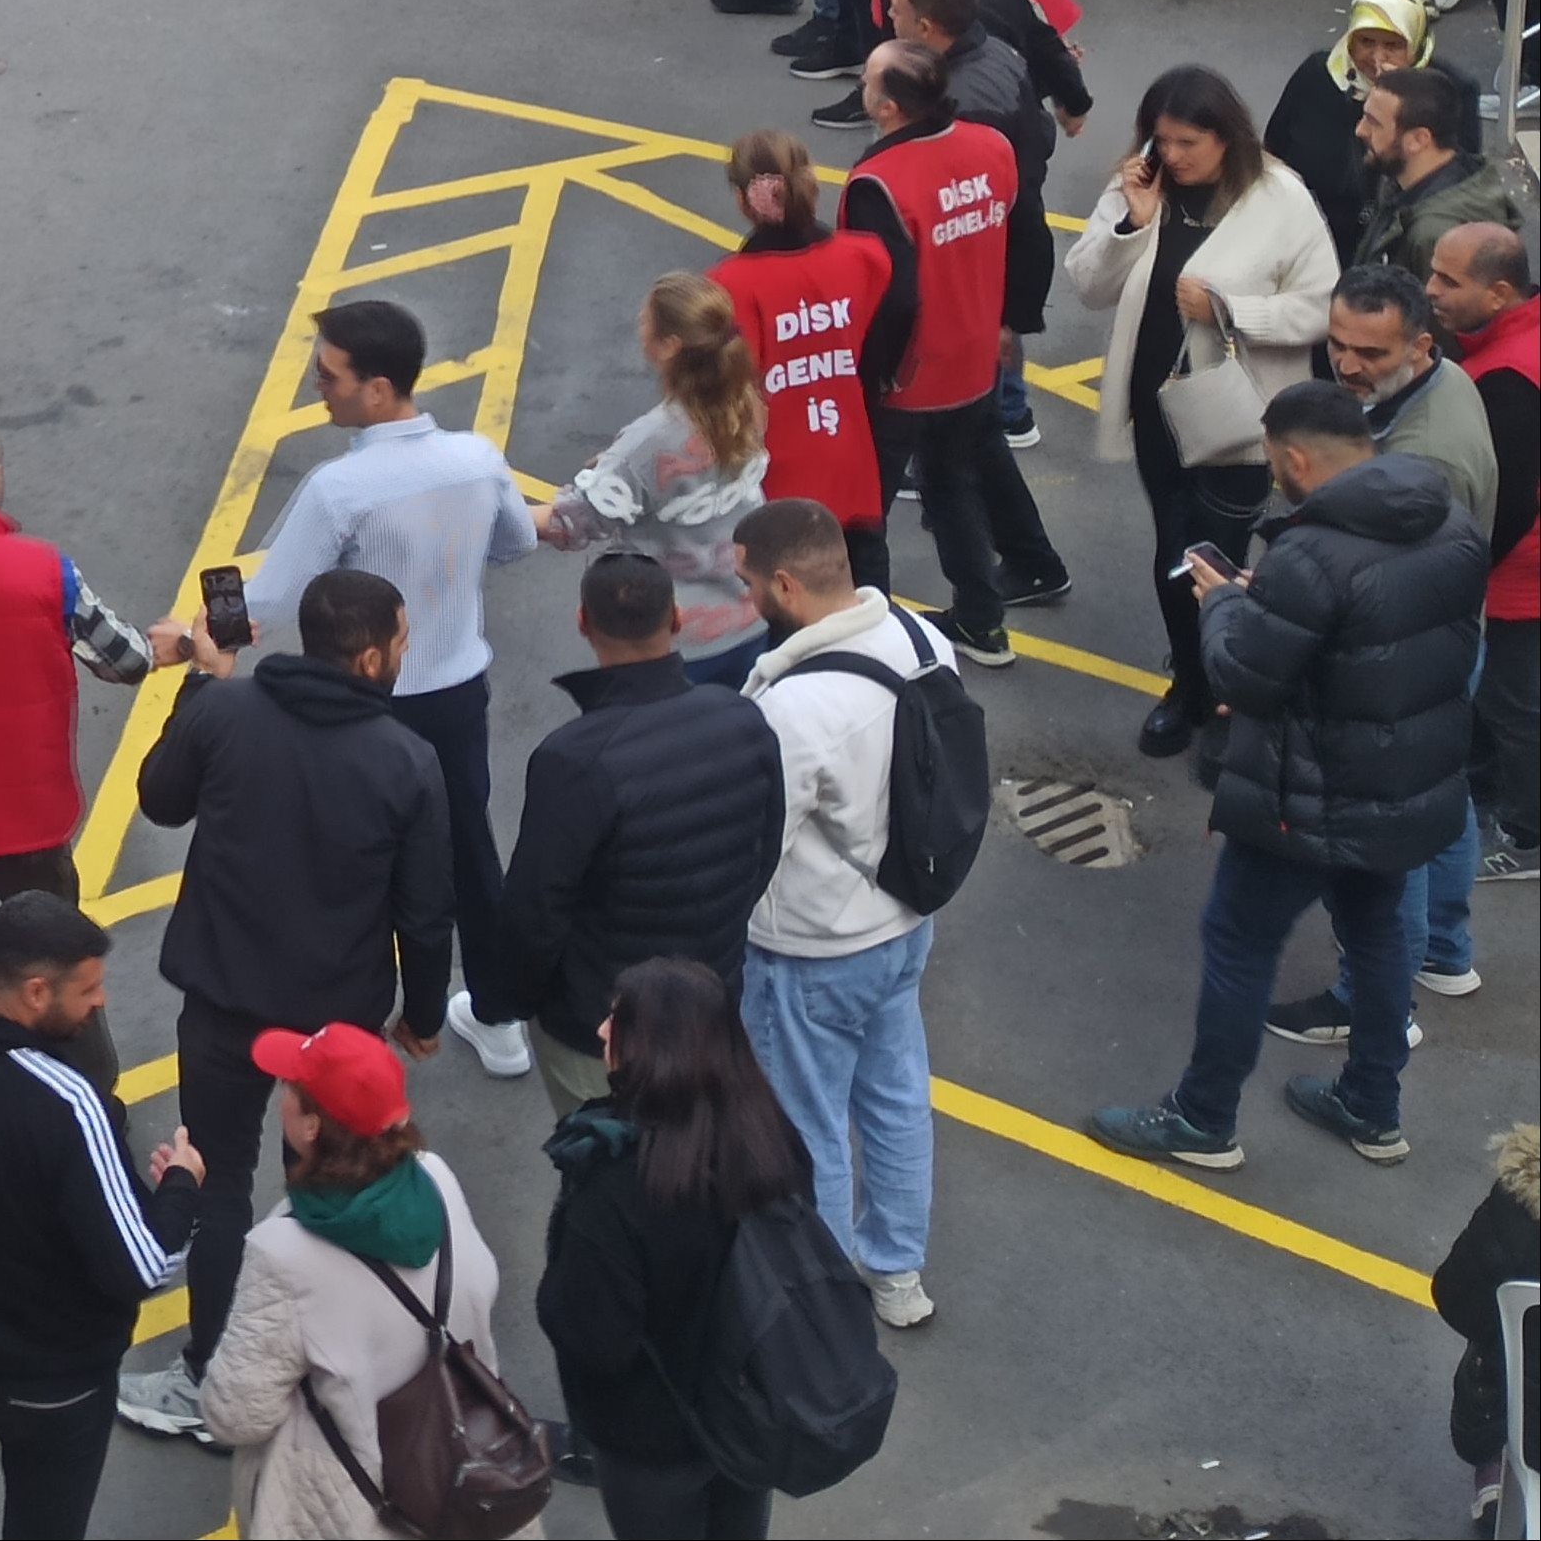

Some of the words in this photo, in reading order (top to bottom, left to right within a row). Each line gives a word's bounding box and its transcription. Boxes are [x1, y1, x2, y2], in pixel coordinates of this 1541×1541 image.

[938, 173, 993, 213] DİSK
[775, 298, 852, 342] DİSK
[765, 349, 857, 394] GENE
[807, 396, 840, 436] İŞ
